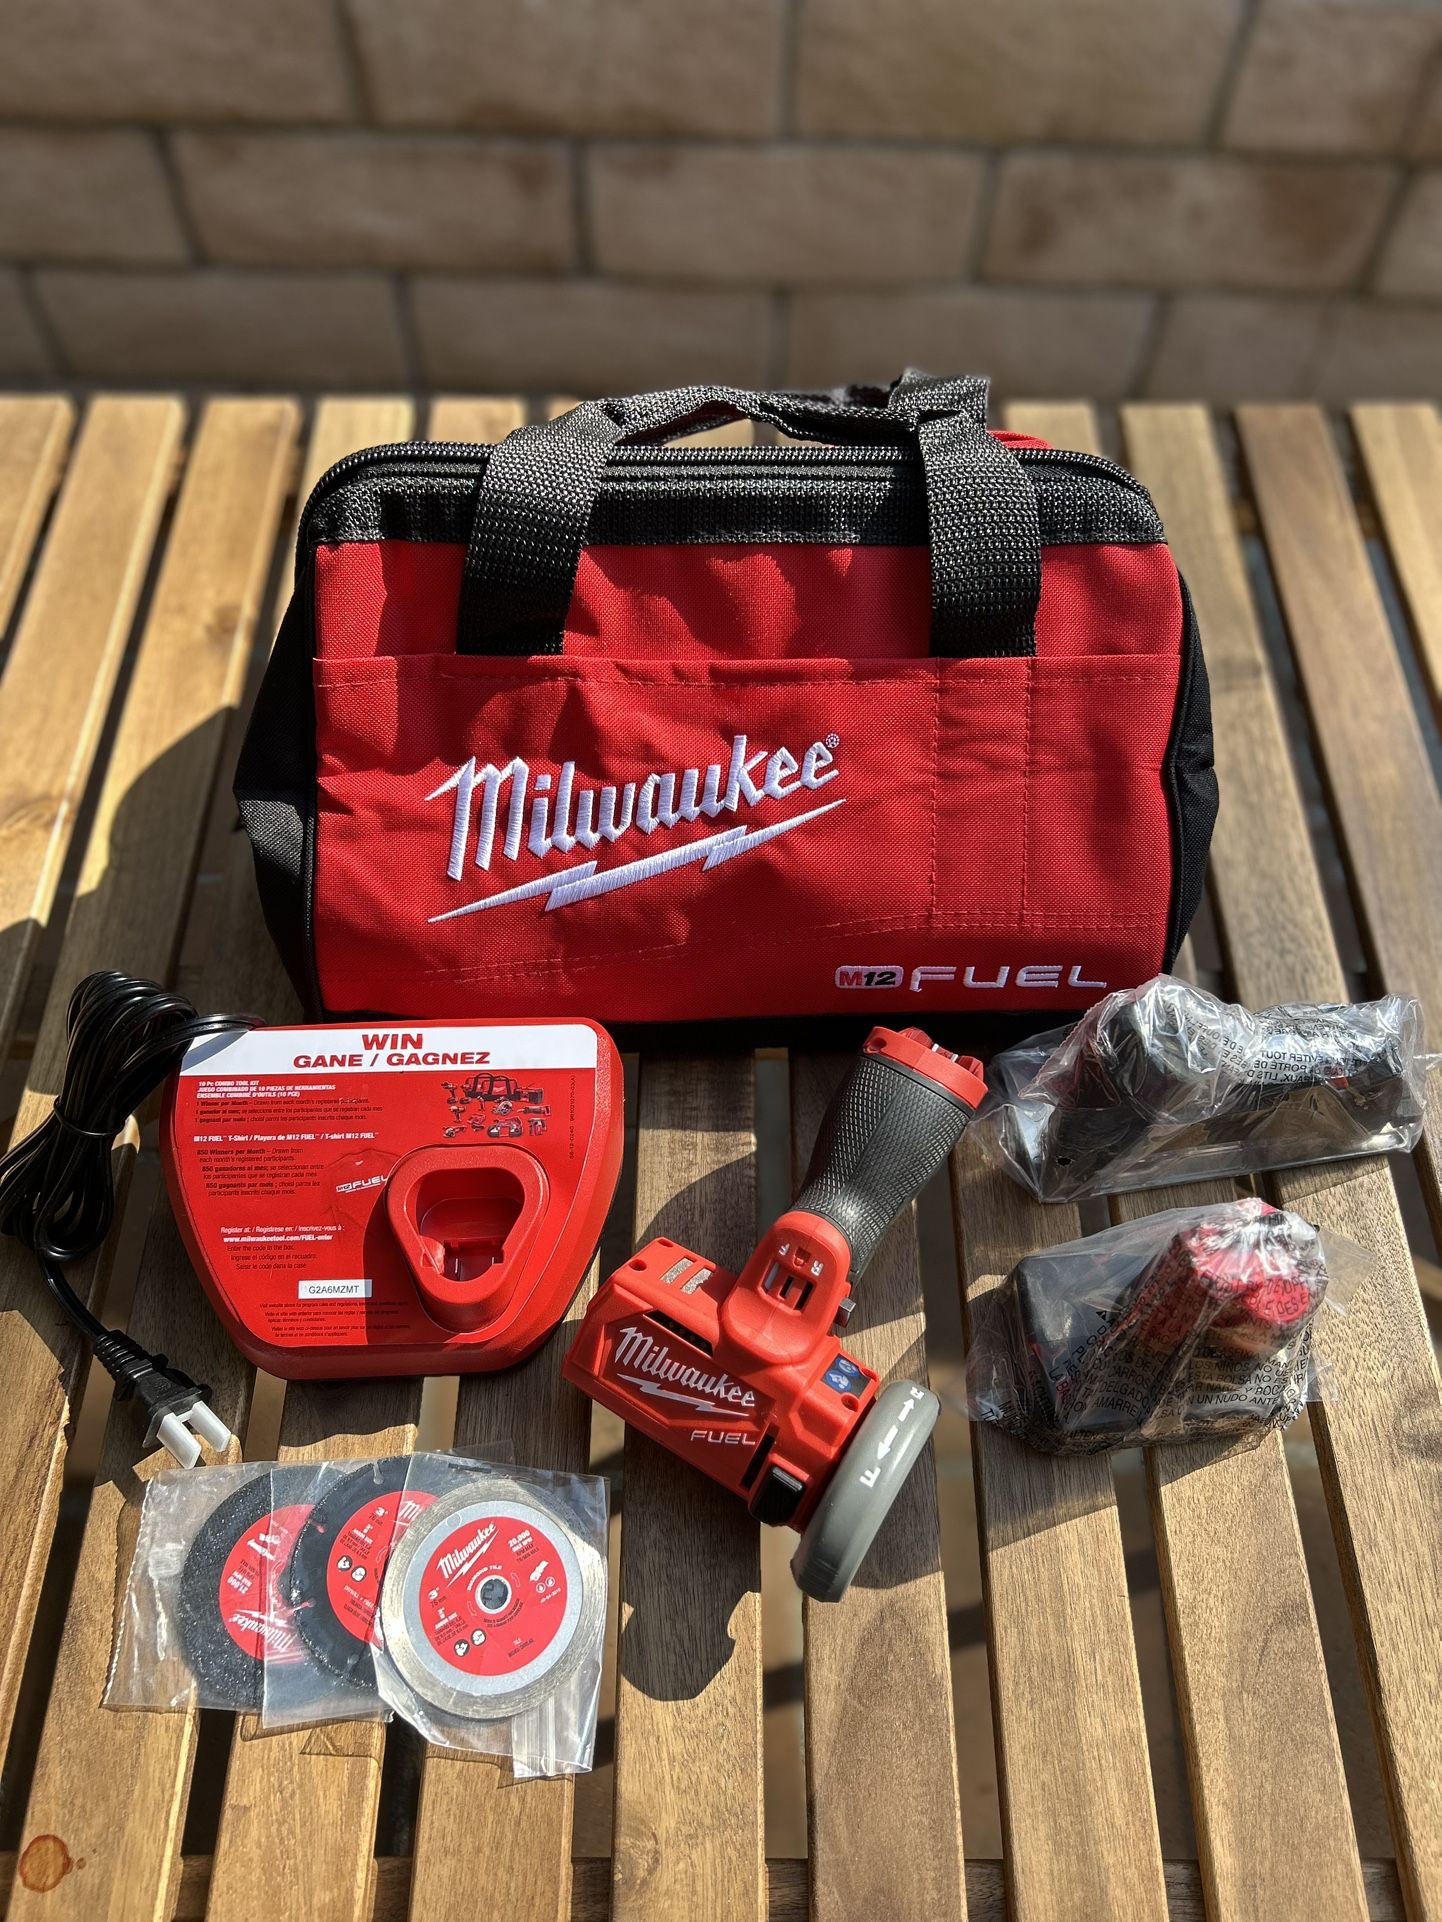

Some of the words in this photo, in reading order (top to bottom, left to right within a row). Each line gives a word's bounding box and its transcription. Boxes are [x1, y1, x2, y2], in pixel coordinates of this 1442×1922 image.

[424, 734, 839, 881] Milwaukee
[838, 968, 898, 987] M12
[909, 965, 1107, 992] FUEL
[362, 1033, 423, 1050] WIN
[293, 1054, 363, 1068] GANE
[370, 1054, 379, 1067] /
[386, 1052, 491, 1066] GAGNEZ
[308, 1285, 360, 1294] G2A6MZMT
[614, 1327, 755, 1407] Milwaukee
[690, 1430, 756, 1445] FUEL
[859, 1466, 881, 1488] F
[508, 1529, 531, 1548] 20,000
[436, 1521, 497, 1579] Milwaukee
